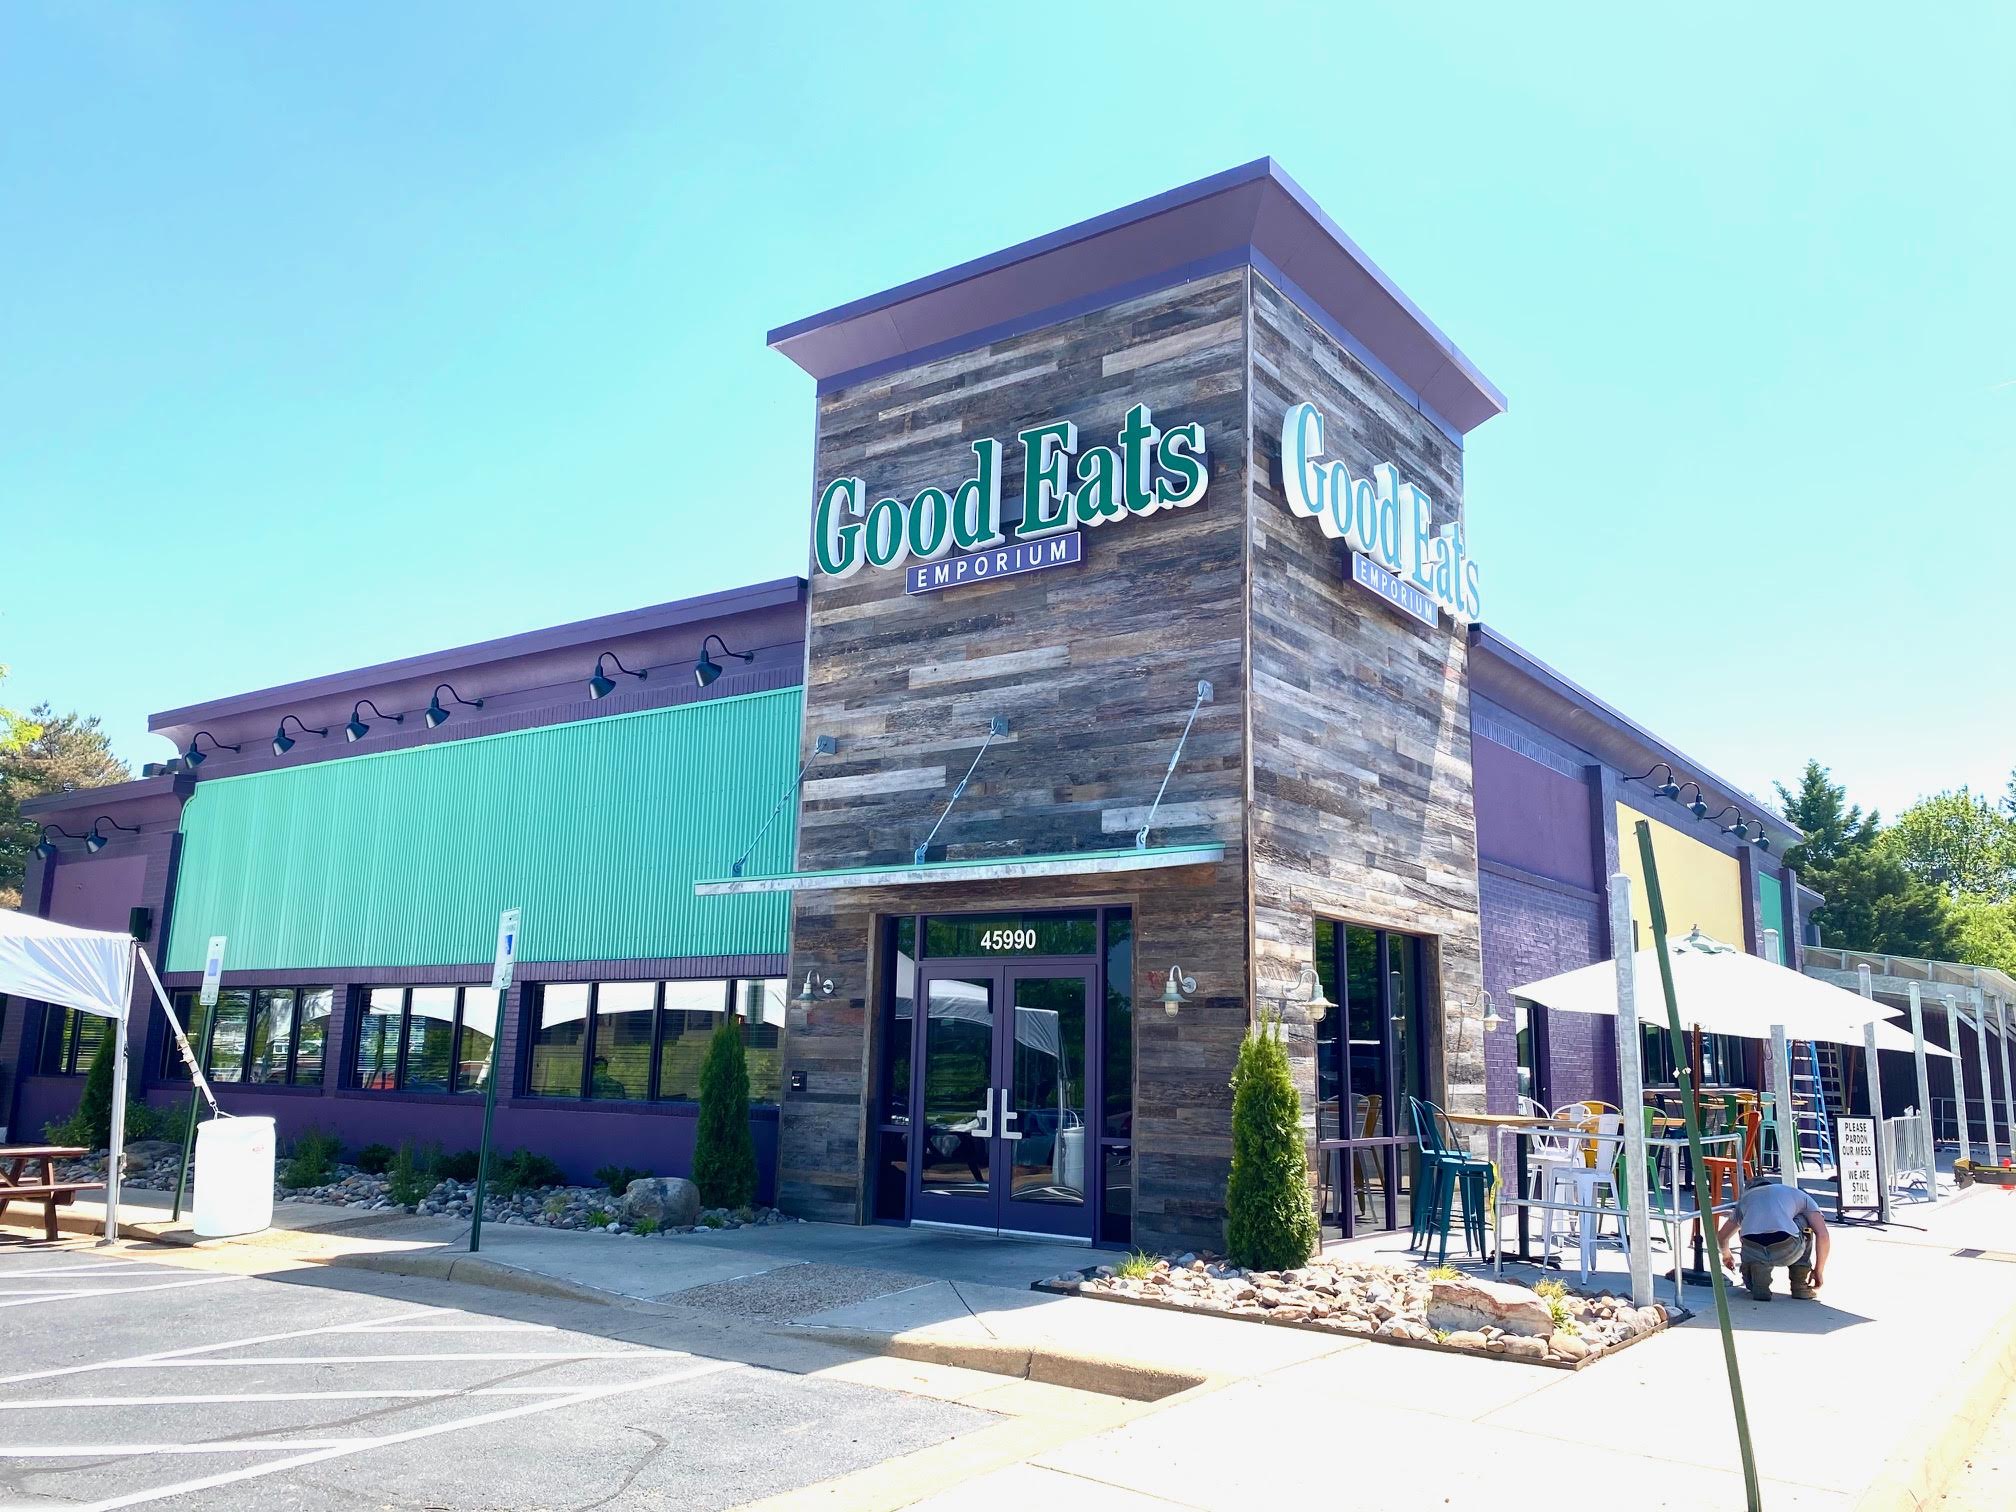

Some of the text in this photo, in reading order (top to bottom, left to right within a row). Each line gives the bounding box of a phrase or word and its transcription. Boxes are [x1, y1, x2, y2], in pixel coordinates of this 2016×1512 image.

[815, 402, 1209, 578] Good Eats
[1281, 401, 1481, 622] Good Eats
[917, 540, 1067, 588] EMPORIUM
[1360, 562, 1434, 621] EMPORIUM
[980, 929, 1037, 950] 45990
[1844, 1122, 1867, 1133] PLEASE
[1845, 1134, 1868, 1144] PARDON
[1842, 1145, 1872, 1156] OUR MESS
[1848, 1170, 1870, 1180] WE ARE
[1852, 1182, 1869, 1192] STILL
